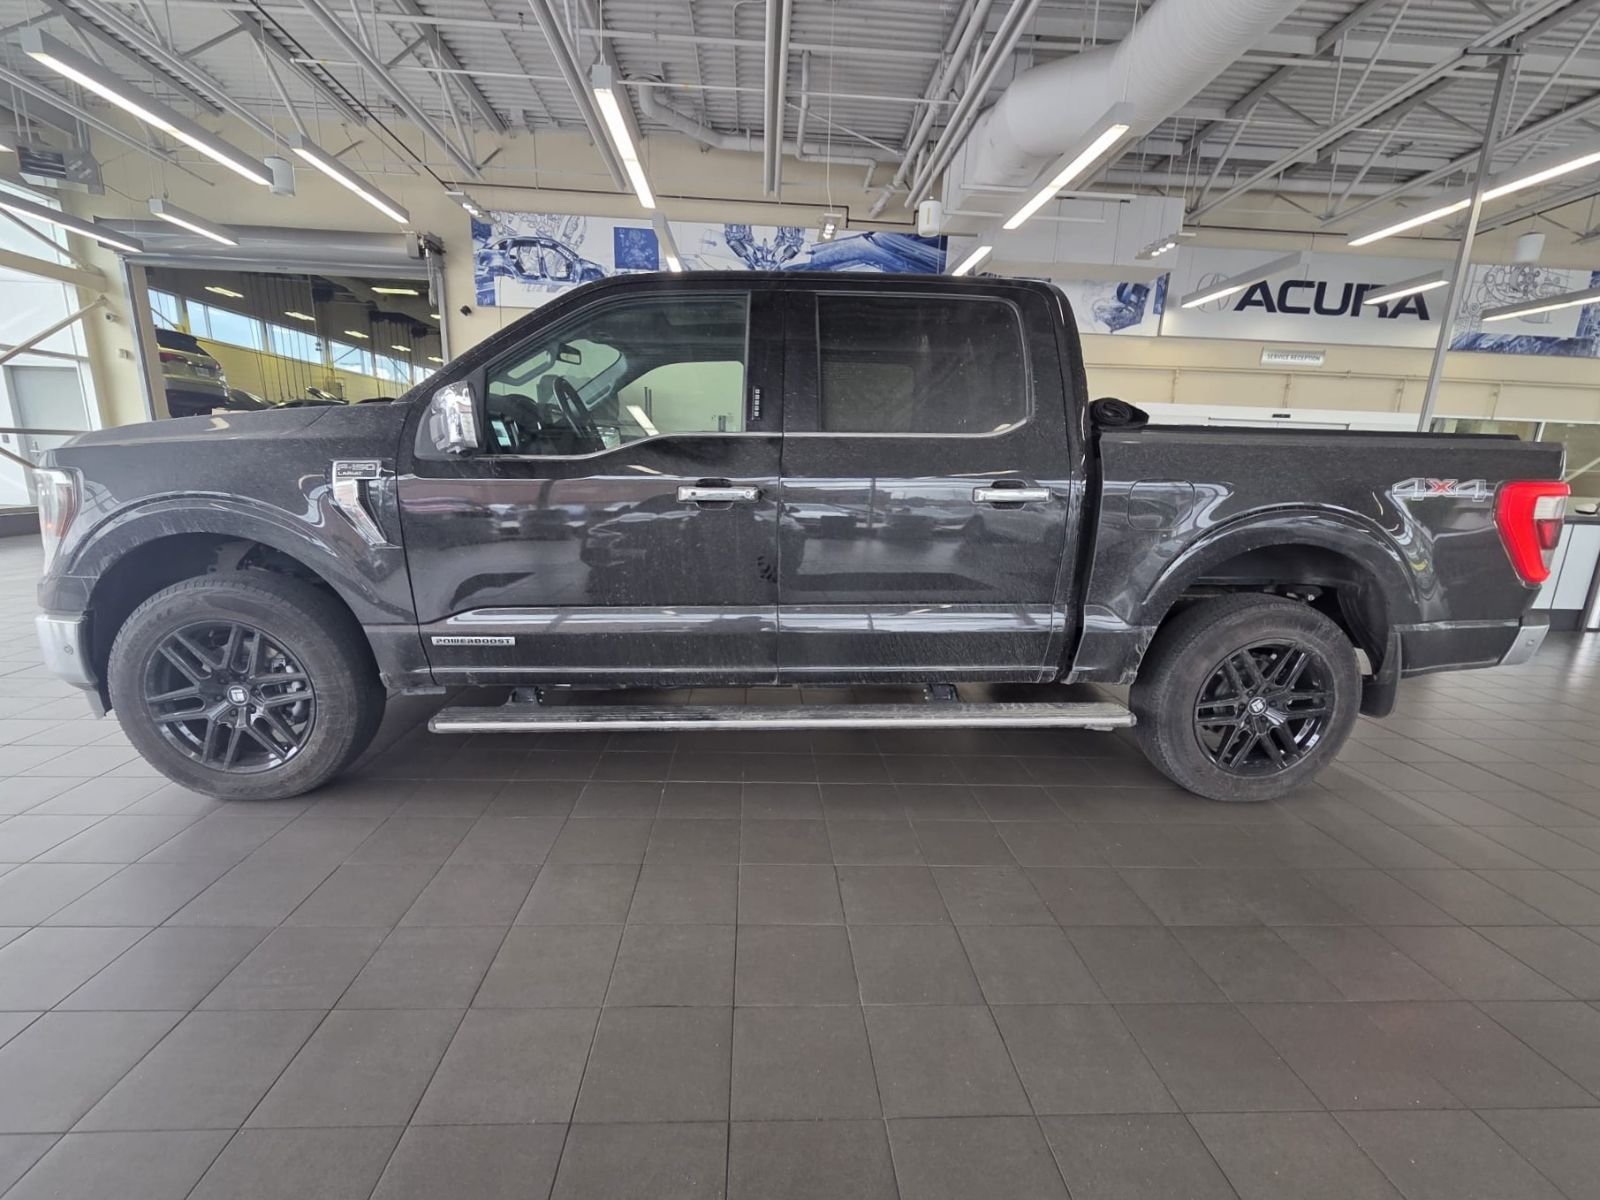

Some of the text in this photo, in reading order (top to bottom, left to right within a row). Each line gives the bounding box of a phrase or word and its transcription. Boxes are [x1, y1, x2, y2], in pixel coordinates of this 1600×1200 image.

[1233, 280, 1430, 320] ACURA
[1290, 353, 1321, 361] RECEPTION
[337, 463, 376, 471] F-150
